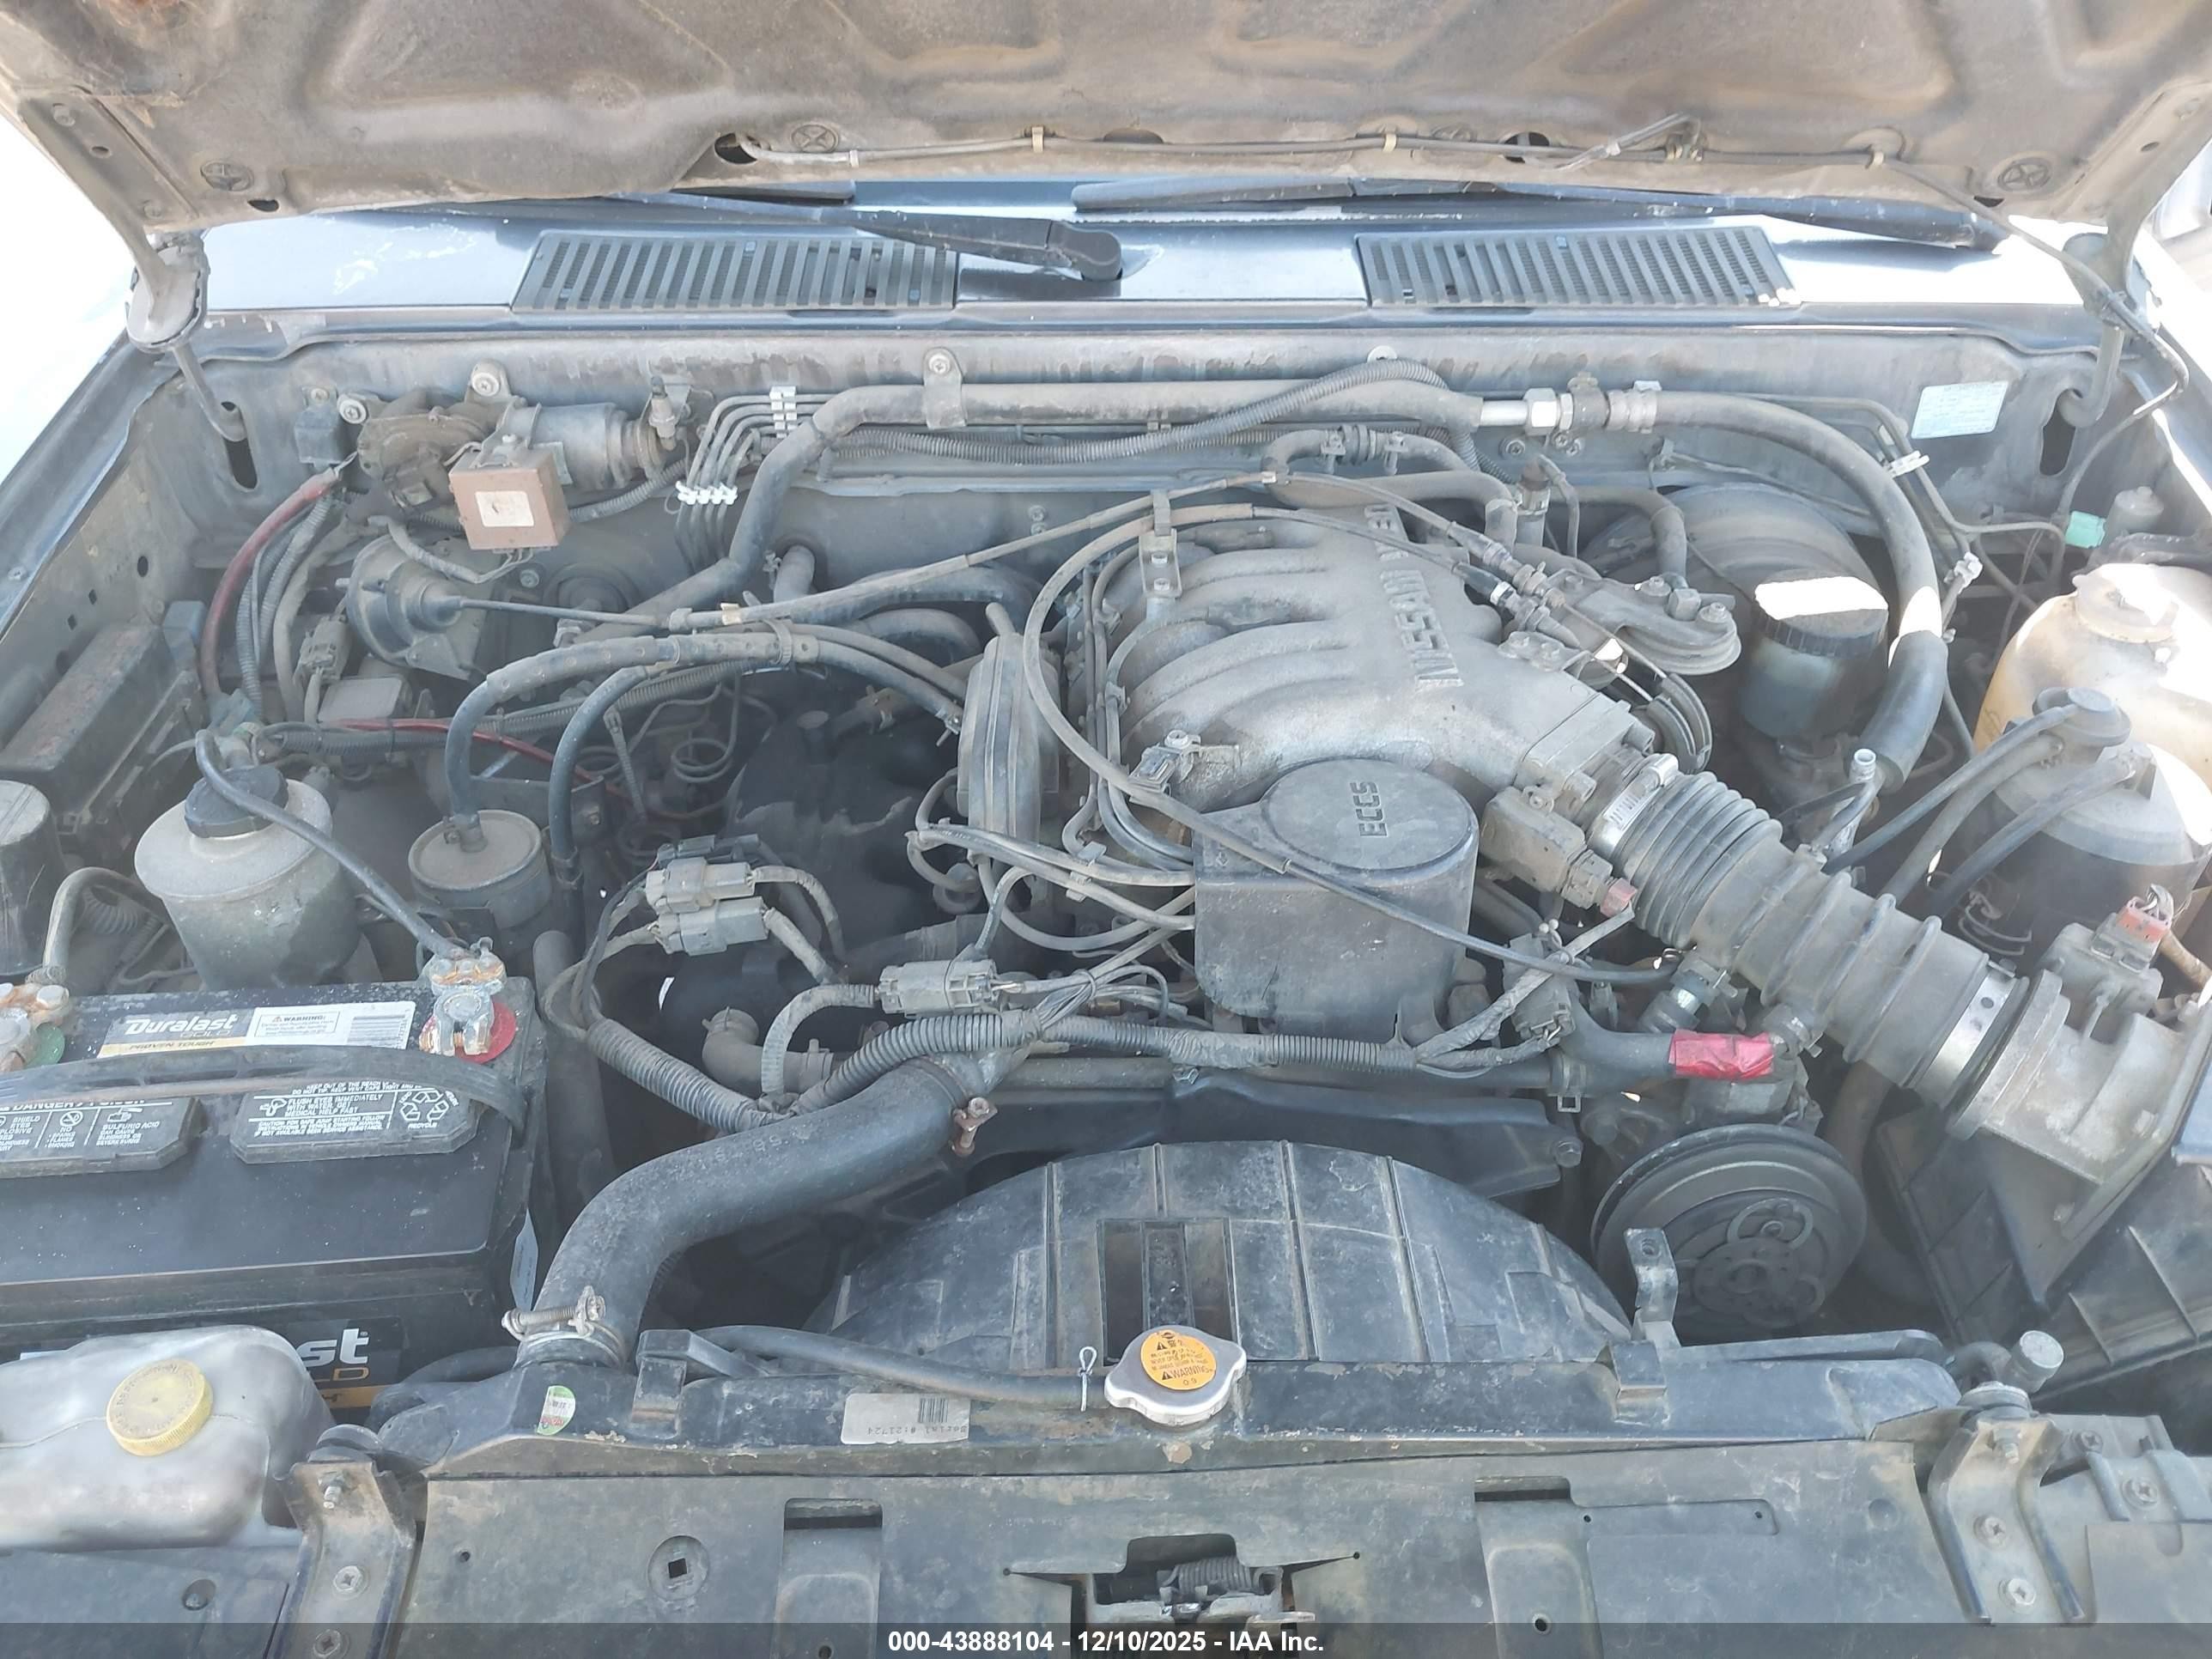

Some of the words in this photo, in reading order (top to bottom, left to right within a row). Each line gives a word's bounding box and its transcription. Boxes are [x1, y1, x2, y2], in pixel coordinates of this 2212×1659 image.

[1380, 569, 1464, 687] NISSAN
[1349, 782, 1388, 836] ECCS
[125, 1014, 238, 1035] Duralast
[130, 1042, 174, 1050] PROVEN
[178, 1040, 216, 1048] TOUGH
[102, 1121, 141, 1131] SULFURIC
[141, 1121, 161, 1129] ACID
